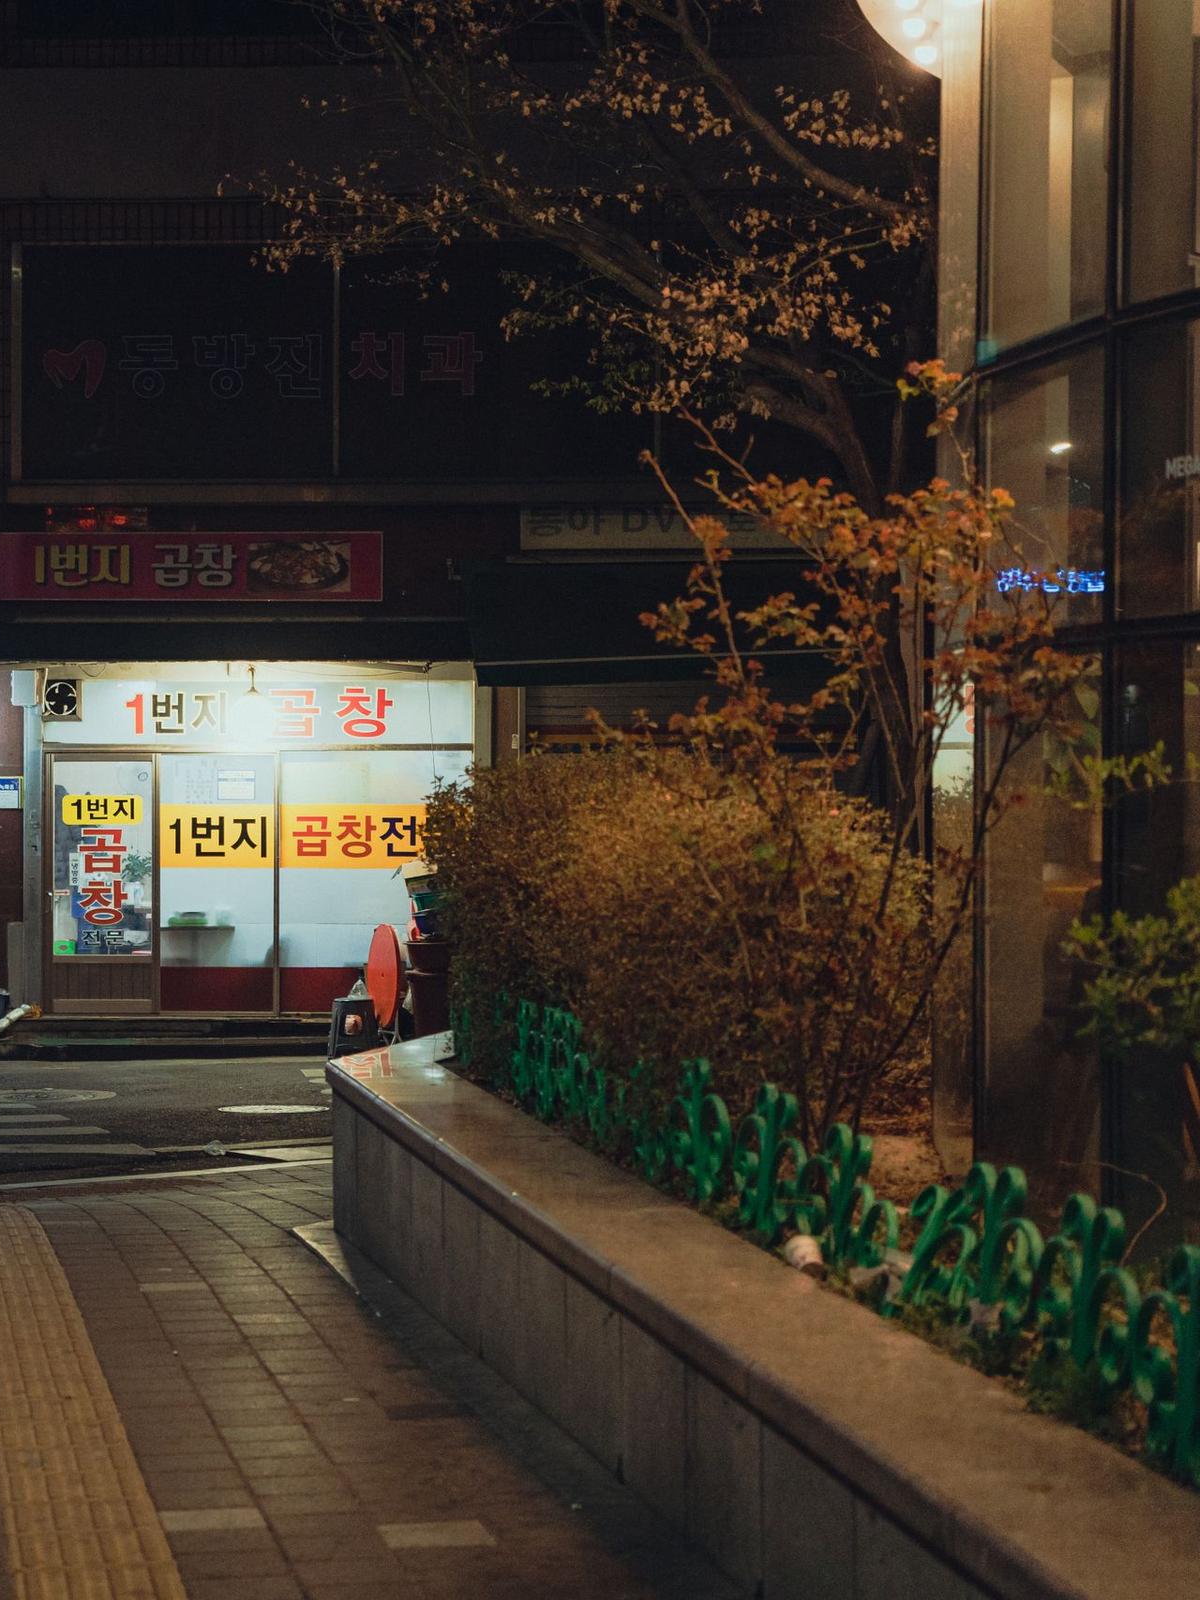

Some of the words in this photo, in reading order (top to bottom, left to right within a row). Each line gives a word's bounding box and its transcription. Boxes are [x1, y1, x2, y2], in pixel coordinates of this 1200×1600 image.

[118, 333, 323, 399] 동방진
[349, 331, 483, 398] 치과
[34, 543, 133, 588] 1번지
[152, 542, 238, 590] 곱창
[125, 690, 228, 738] 1번지
[267, 687, 394, 739] 곱창
[70, 797, 136, 821] 1번지
[169, 815, 268, 859] 1번지
[77, 826, 129, 927] 곱창
[81, 928, 126, 947] 전문
